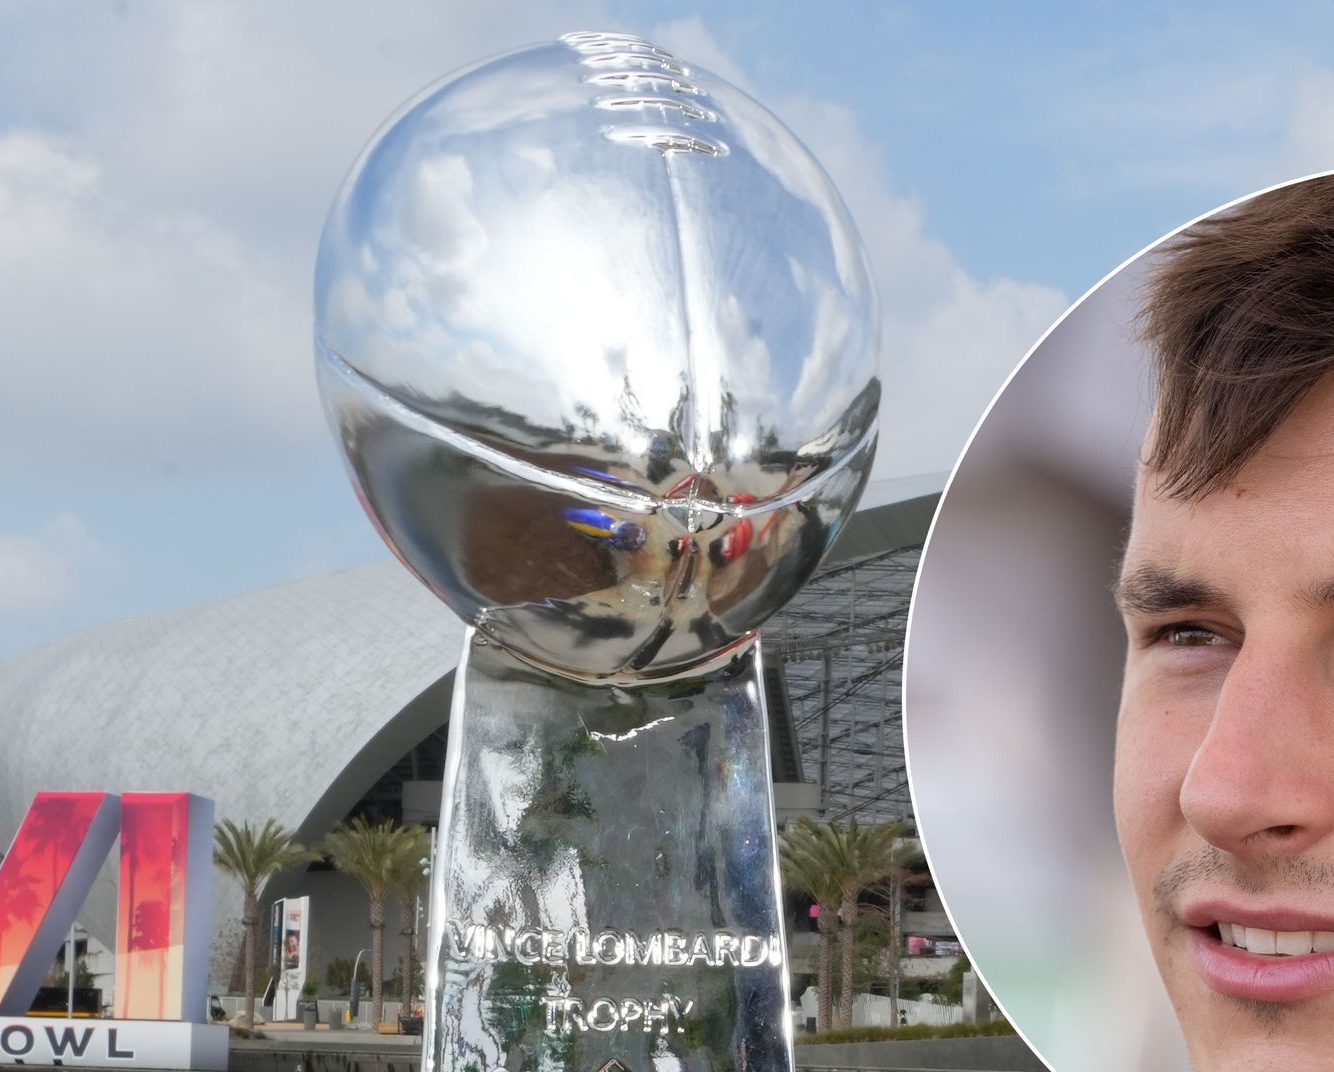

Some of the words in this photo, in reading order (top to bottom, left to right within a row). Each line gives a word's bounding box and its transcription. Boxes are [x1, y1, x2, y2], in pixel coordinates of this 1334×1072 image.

[444, 919, 564, 966] VINCE
[573, 926, 782, 967] LOMBARDI
[539, 994, 694, 1034] TROPHY
